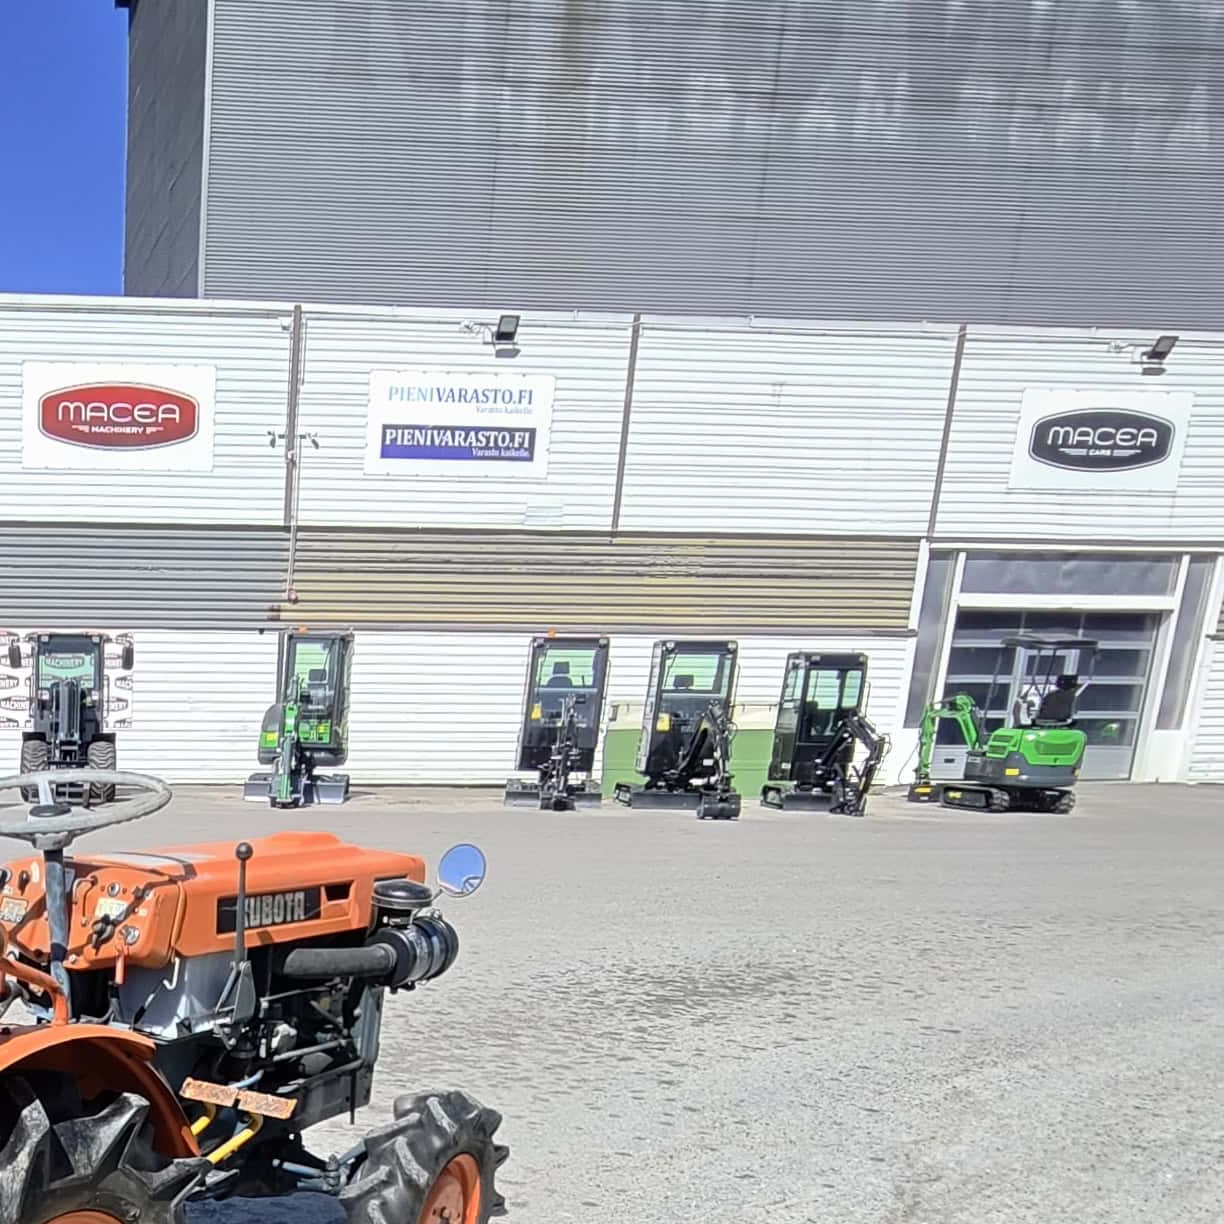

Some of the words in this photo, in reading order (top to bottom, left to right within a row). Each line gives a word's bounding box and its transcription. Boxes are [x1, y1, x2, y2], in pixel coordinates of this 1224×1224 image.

[388, 385, 534, 405] PIENIVARASTO.FI
[58, 401, 180, 424] MACEA
[91, 425, 144, 435] MACHINERY
[384, 428, 530, 448] PIENIVARASTO.FI
[1047, 426, 1158, 448] MACEA
[472, 447, 500, 457] Varasto
